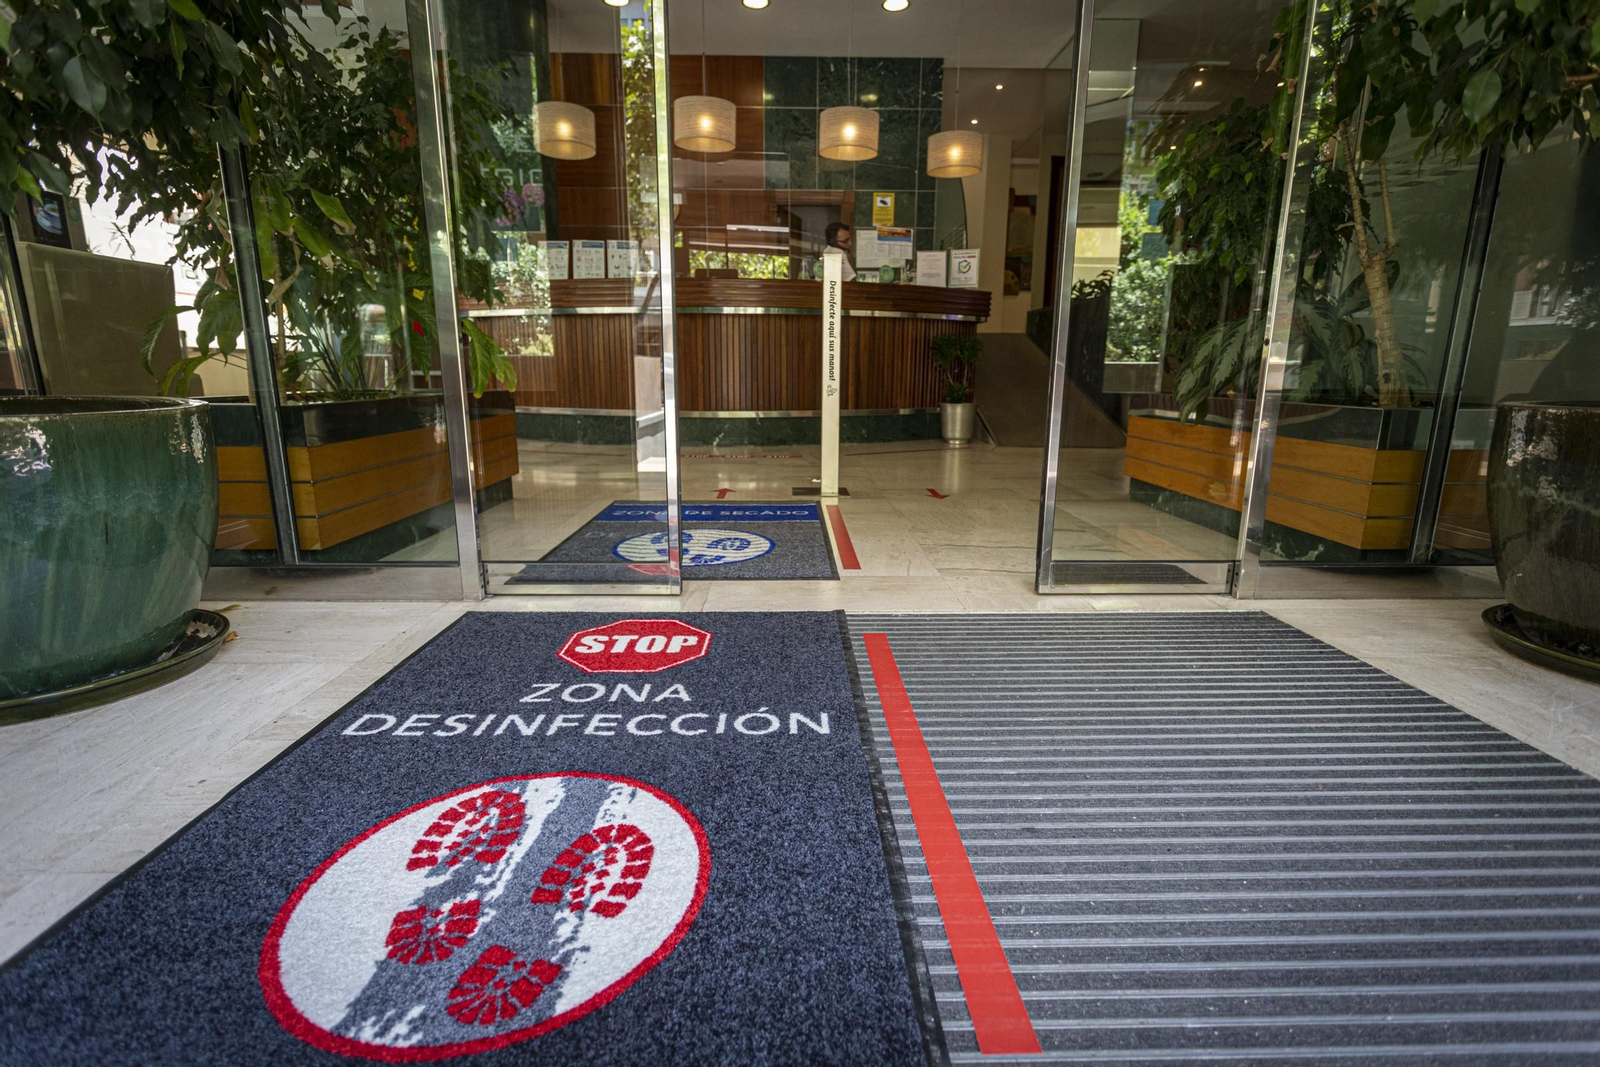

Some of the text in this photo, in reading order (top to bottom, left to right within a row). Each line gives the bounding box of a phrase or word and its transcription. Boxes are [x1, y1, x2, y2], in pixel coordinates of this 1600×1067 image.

[828, 280, 837, 320] Desinfecte
[828, 320, 836, 339] aquí
[828, 353, 836, 381] manos!
[574, 634, 699, 654] STOP
[518, 683, 692, 703] ZONA
[341, 707, 831, 737] DESINFECCIÓN
